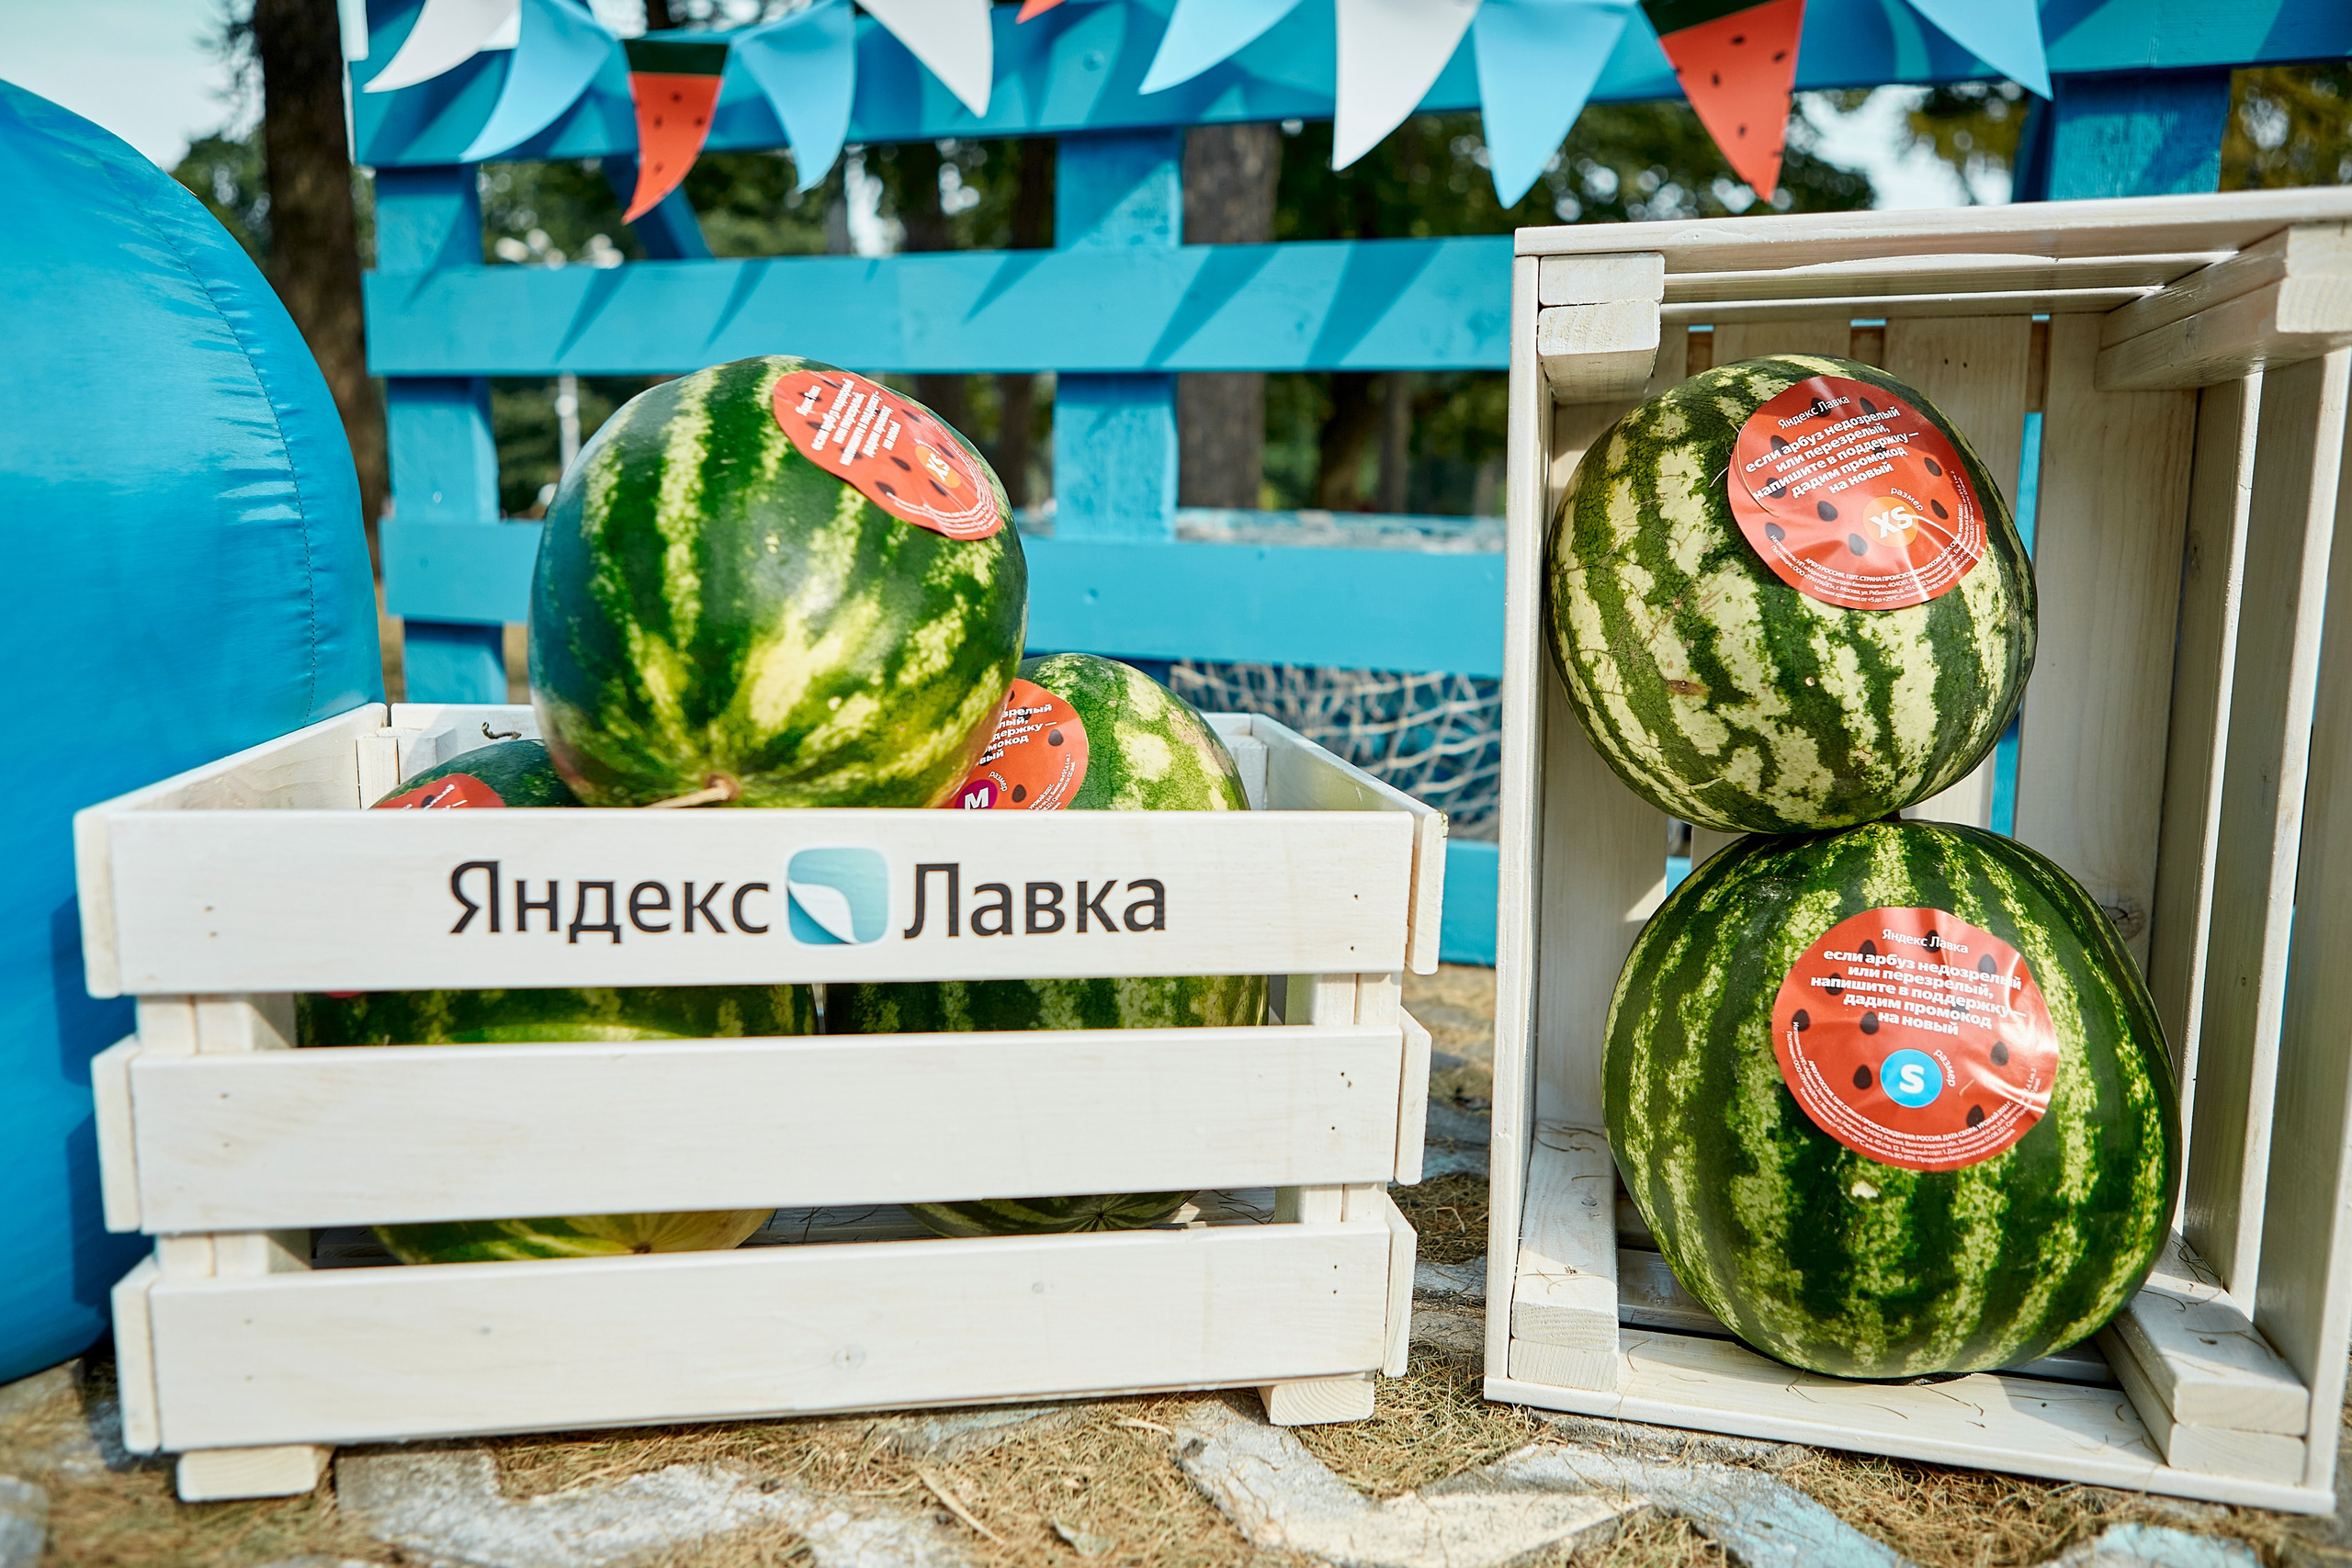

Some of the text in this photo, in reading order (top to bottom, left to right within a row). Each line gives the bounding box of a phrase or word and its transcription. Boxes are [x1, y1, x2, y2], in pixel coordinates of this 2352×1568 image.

[1779, 395, 1850, 430] Яндекс Лавка
[1745, 406, 1901, 474] если арбуз недозрелый
[1776, 423, 1891, 473] или перезрелый,
[1752, 459, 1827, 502] напишите
[1826, 456, 1838, 466] в
[1838, 434, 1908, 461] поддержку
[1791, 446, 1908, 499] дадим промокод
[1828, 461, 1894, 494] на новый
[1890, 486, 1924, 513] размер
[1869, 505, 1914, 539] XS
[964, 786, 989, 810] M
[989, 771, 1008, 792] размер
[448, 859, 1167, 944] Яндекс Лавка
[1882, 928, 1969, 954] Яндекс Лавка
[1823, 949, 2021, 991] если арбуз недозрелый
[1848, 964, 1995, 998] или перезрелый,
[1810, 976, 1896, 996] напишите
[1898, 985, 1908, 997] в
[1910, 987, 2008, 1019] поддержку
[1843, 992, 1993, 1031] дадим промокод
[1878, 1011, 1959, 1036] на новый
[1898, 1063, 1925, 1095] S
[1932, 1048, 1956, 1089] размер
[1941, 1132, 1959, 1140] ДАТА
